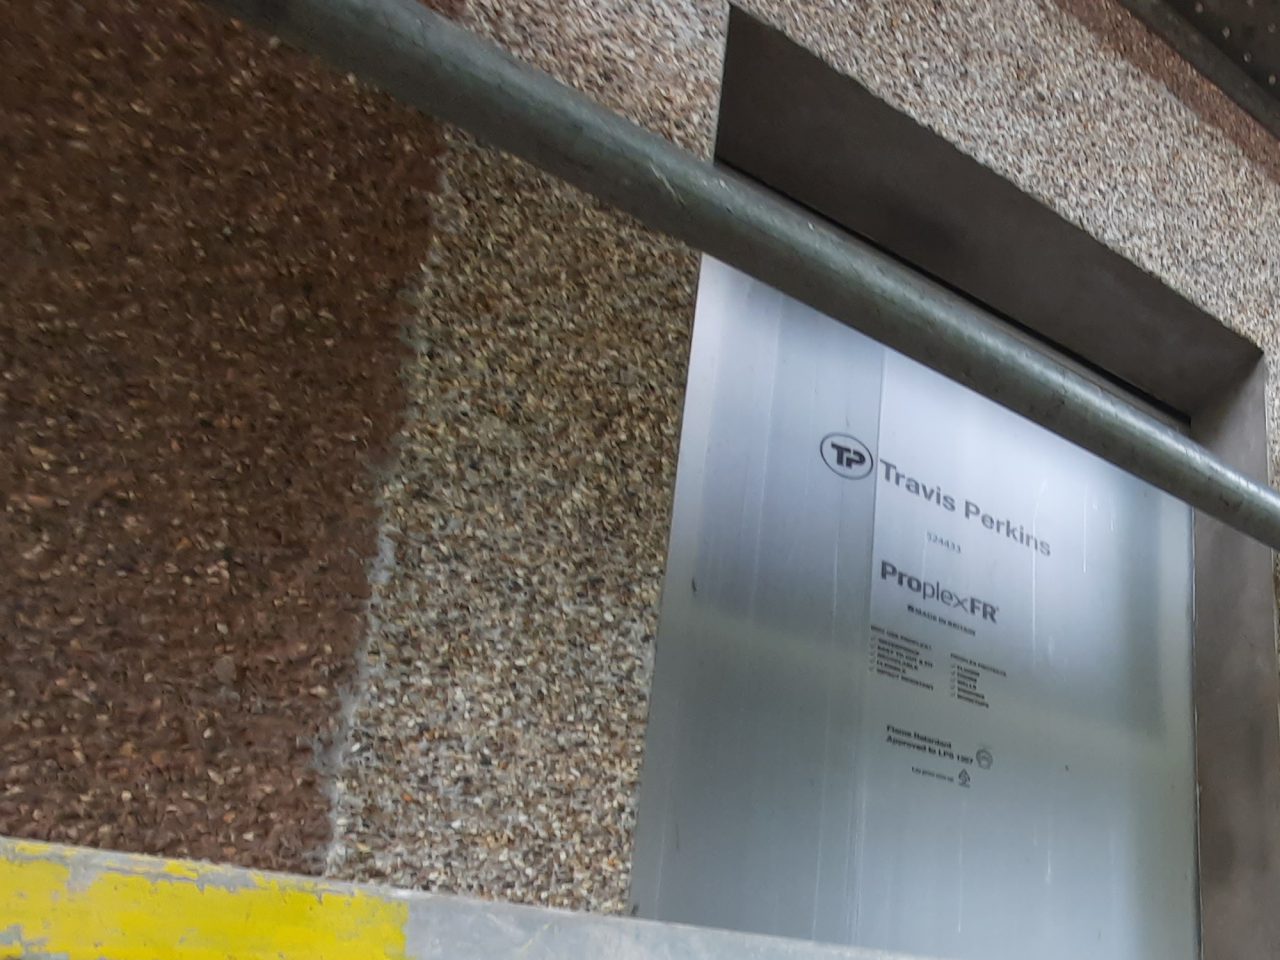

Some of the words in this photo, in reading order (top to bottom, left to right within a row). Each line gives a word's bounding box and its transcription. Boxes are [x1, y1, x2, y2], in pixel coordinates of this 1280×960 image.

[831, 441, 866, 469] TP
[880, 459, 956, 512] Travis
[964, 499, 1051, 556] Perkins
